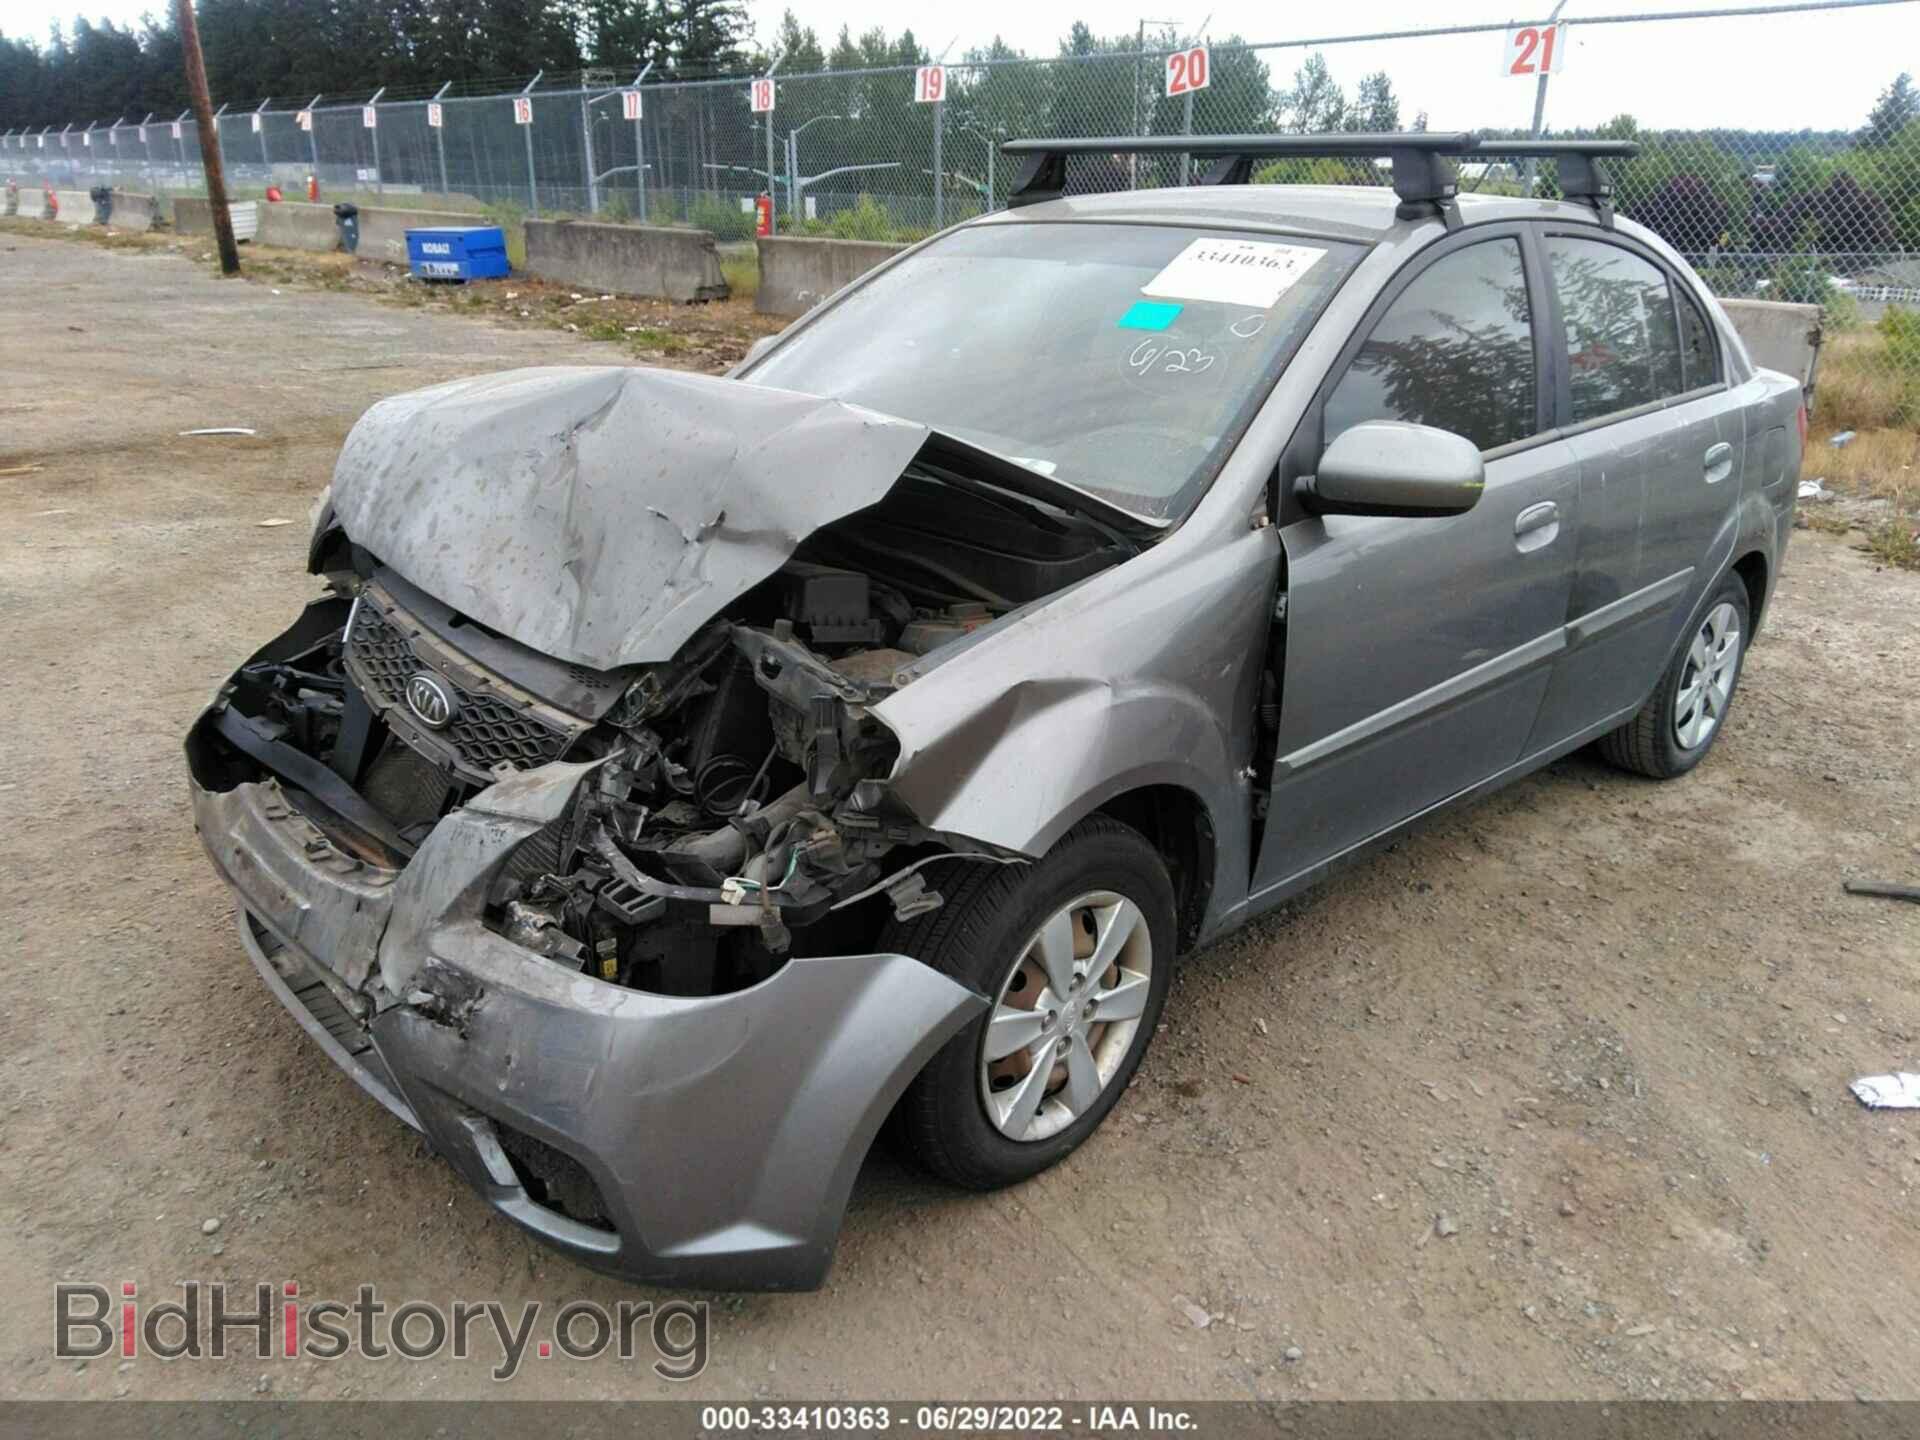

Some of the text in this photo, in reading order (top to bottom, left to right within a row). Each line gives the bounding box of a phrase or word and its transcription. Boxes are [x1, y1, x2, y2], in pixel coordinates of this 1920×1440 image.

[1510, 26, 1555, 74] 21
[920, 68, 941, 100] 19
[1169, 49, 1206, 94] 20
[517, 99, 529, 121] 16
[627, 93, 638, 117] 17
[754, 82, 770, 110] 18
